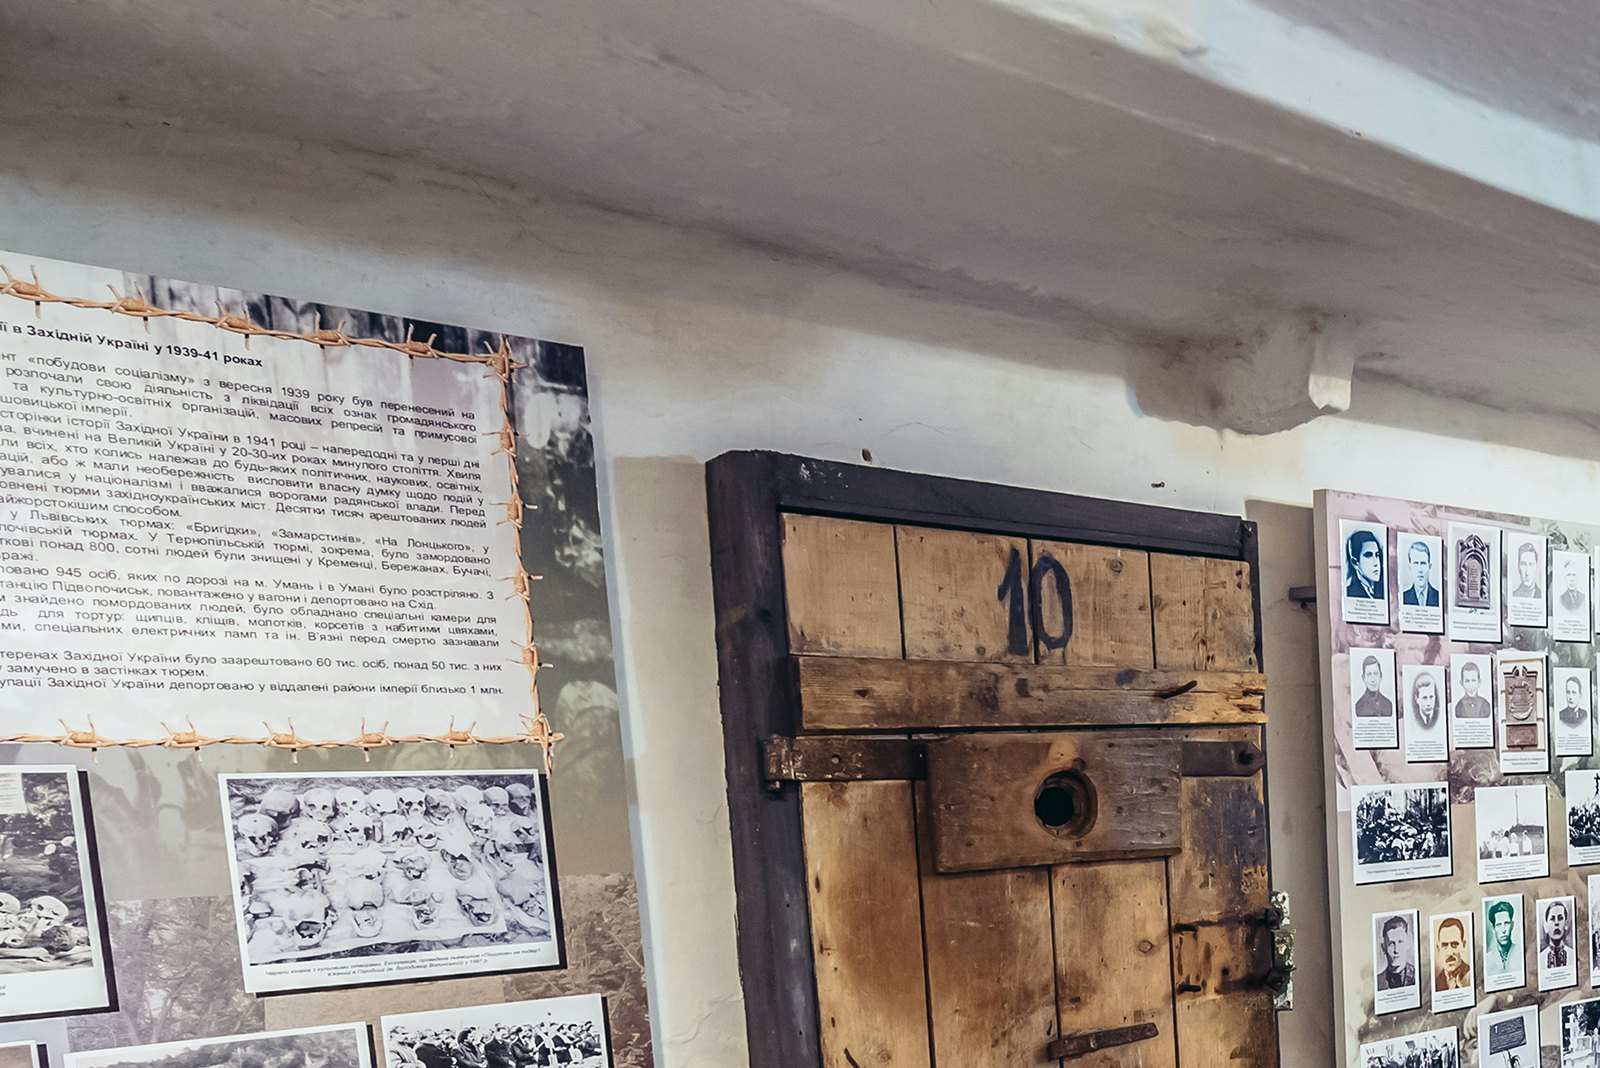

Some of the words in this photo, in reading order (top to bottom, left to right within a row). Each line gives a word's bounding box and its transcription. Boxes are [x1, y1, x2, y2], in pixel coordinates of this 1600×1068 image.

[26, 325, 92, 343] Західній
[95, 335, 149, 351] Україні
[153, 345, 162, 355] у
[165, 345, 218, 360] 1939-41
[222, 355, 262, 367] роках
[5, 368, 83, 384] розпочали
[95, 379, 131, 390] свою
[143, 385, 213, 400] діяльність
[241, 396, 299, 411] ліквідації
[310, 405, 334, 415] всіх
[343, 410, 377, 420] ознак
[27, 357, 105, 373] «побудови
[114, 368, 194, 385] соціалізму»
[218, 381, 272, 394] вересня
[281, 387, 310, 399] 1939
[317, 394, 345, 405] року
[351, 396, 373, 408] був
[380, 402, 455, 417] перенесений
[12, 382, 28, 391] та
[269, 413, 322, 426] масових
[330, 421, 383, 433] репресій
[0, 410, 61, 423] сторінки
[66, 418, 110, 430] історії
[115, 421, 173, 436] Західної
[177, 428, 229, 442] України
[246, 436, 275, 447] 1941
[280, 441, 306, 451] році
[321, 446, 397, 460] напередодні
[427, 457, 460, 467] перші
[462, 460, 480, 469] дні
[23, 427, 78, 439] вчинені
[84, 433, 101, 442] на
[108, 434, 161, 448] Великій
[167, 440, 214, 453] Україні
[231, 447, 286, 461] 20-30-их
[291, 455, 327, 465] роках
[332, 459, 387, 471] минулого
[446, 469, 481, 480] Хвиля
[65, 445, 88, 454] хто
[94, 448, 142, 459] колись
[148, 454, 207, 466] належав
[212, 460, 229, 469] до
[234, 460, 296, 475] будь-яких
[41, 455, 68, 466] або
[93, 462, 129, 471] мали
[247, 476, 313, 488] висловити
[319, 483, 360, 495] власну
[366, 488, 400, 499] думку
[405, 491, 437, 501] щодо
[443, 495, 472, 504] подій
[53, 485, 100, 496] тюрми
[275, 502, 325, 515] Десятки
[331, 509, 364, 518] тисяч
[369, 513, 446, 525] арештованих
[450, 519, 486, 528] людей
[190, 484, 262, 497] вважалися
[268, 491, 327, 502] ворогами
[333, 497, 399, 509] радянської
[449, 505, 485, 517] Перед
[30, 510, 108, 525] Львівських
[375, 537, 397, 546] «На
[39, 540, 84, 552] понад
[124, 546, 159, 555] сотні
[165, 549, 209, 558] людей
[213, 550, 245, 561] були
[250, 555, 301, 564] знищені
[381, 549, 409, 560] було
[416, 553, 490, 564] замордовано
[55, 567, 82, 577] 945
[127, 573, 157, 581] яких
[163, 575, 180, 583] по
[185, 576, 228, 586] дорозі
[272, 579, 314, 590] Умань
[338, 583, 374, 593] Умані
[378, 585, 407, 596] було
[14, 595, 84, 605] знайдено
[253, 604, 284, 616] було
[289, 606, 357, 618] обладнано
[363, 612, 424, 620] спеціальні
[430, 615, 471, 624] камери
[157, 589, 244, 600] повантажено
[257, 594, 301, 602] вагони
[310, 597, 388, 607] депортовано
[996, 546, 1074, 656] 10
[34, 624, 122, 634] спеціальних
[131, 628, 215, 638] електричних
[349, 635, 386, 644] перед
[392, 637, 436, 646] смертю
[442, 639, 499, 647] зазнавали
[37, 610, 64, 619] для
[314, 622, 364, 630] корсетів
[385, 623, 440, 633] набитими
[7, 665, 77, 675] замучено
[94, 667, 157, 675] застінках
[63, 651, 122, 662] Західної
[126, 653, 180, 664] України
[184, 654, 217, 666] було
[315, 658, 331, 667] 60
[393, 662, 429, 670] понад
[431, 661, 445, 670] 50
[47, 677, 106, 688] Західної
[111, 679, 164, 690] України
[169, 682, 254, 691] депортовано
[269, 682, 328, 692] віддалені
[332, 685, 375, 693] райони
[420, 684, 466, 694] близько
